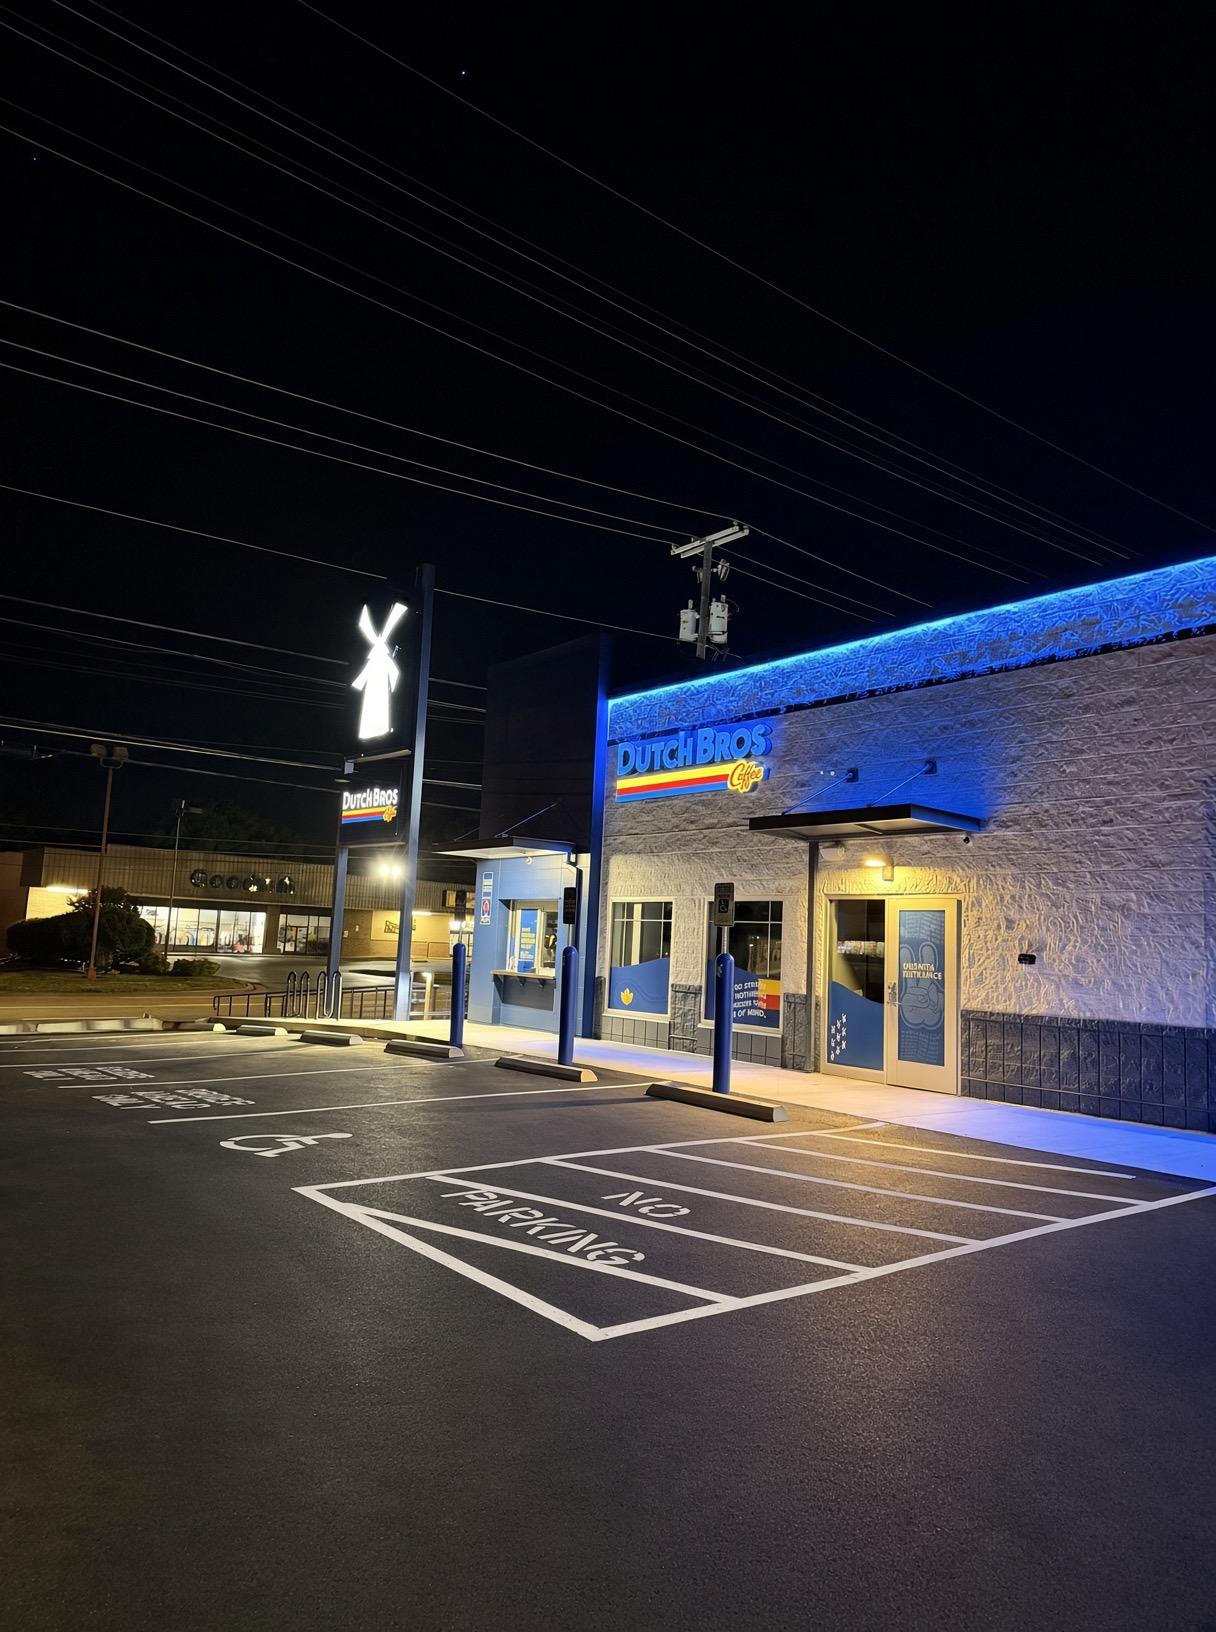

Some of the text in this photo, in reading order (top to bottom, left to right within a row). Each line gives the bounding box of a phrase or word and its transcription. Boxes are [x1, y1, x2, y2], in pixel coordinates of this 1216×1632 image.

[729, 761, 763, 790] Coffee
[600, 1190, 692, 1219] NO
[440, 1189, 647, 1266] PARKING
